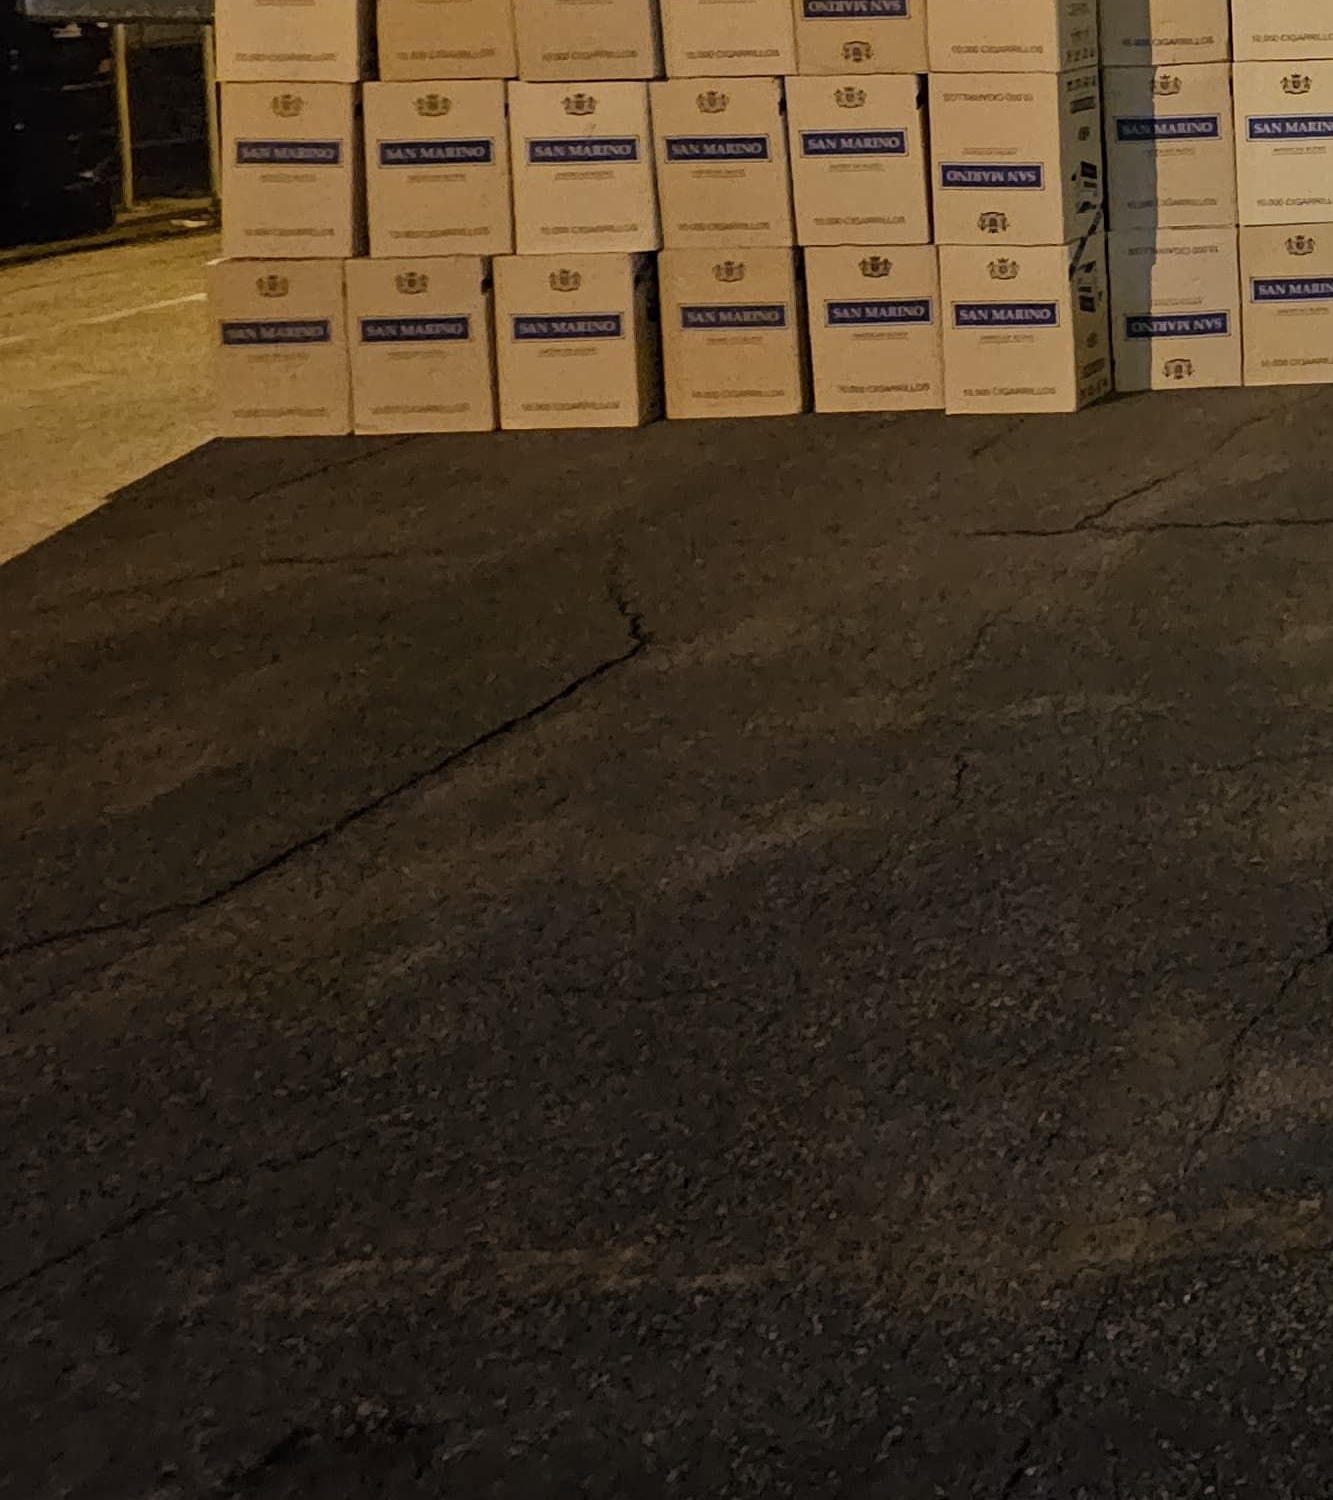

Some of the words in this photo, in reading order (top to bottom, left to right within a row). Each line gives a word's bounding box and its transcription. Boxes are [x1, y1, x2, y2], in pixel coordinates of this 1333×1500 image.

[1254, 121, 1282, 134] SAN
[1258, 283, 1286, 296] SAN
[833, 306, 861, 320] SAN
[866, 304, 924, 318] MARINO
[960, 308, 988, 321] SAN
[993, 308, 1050, 321] MARINO
